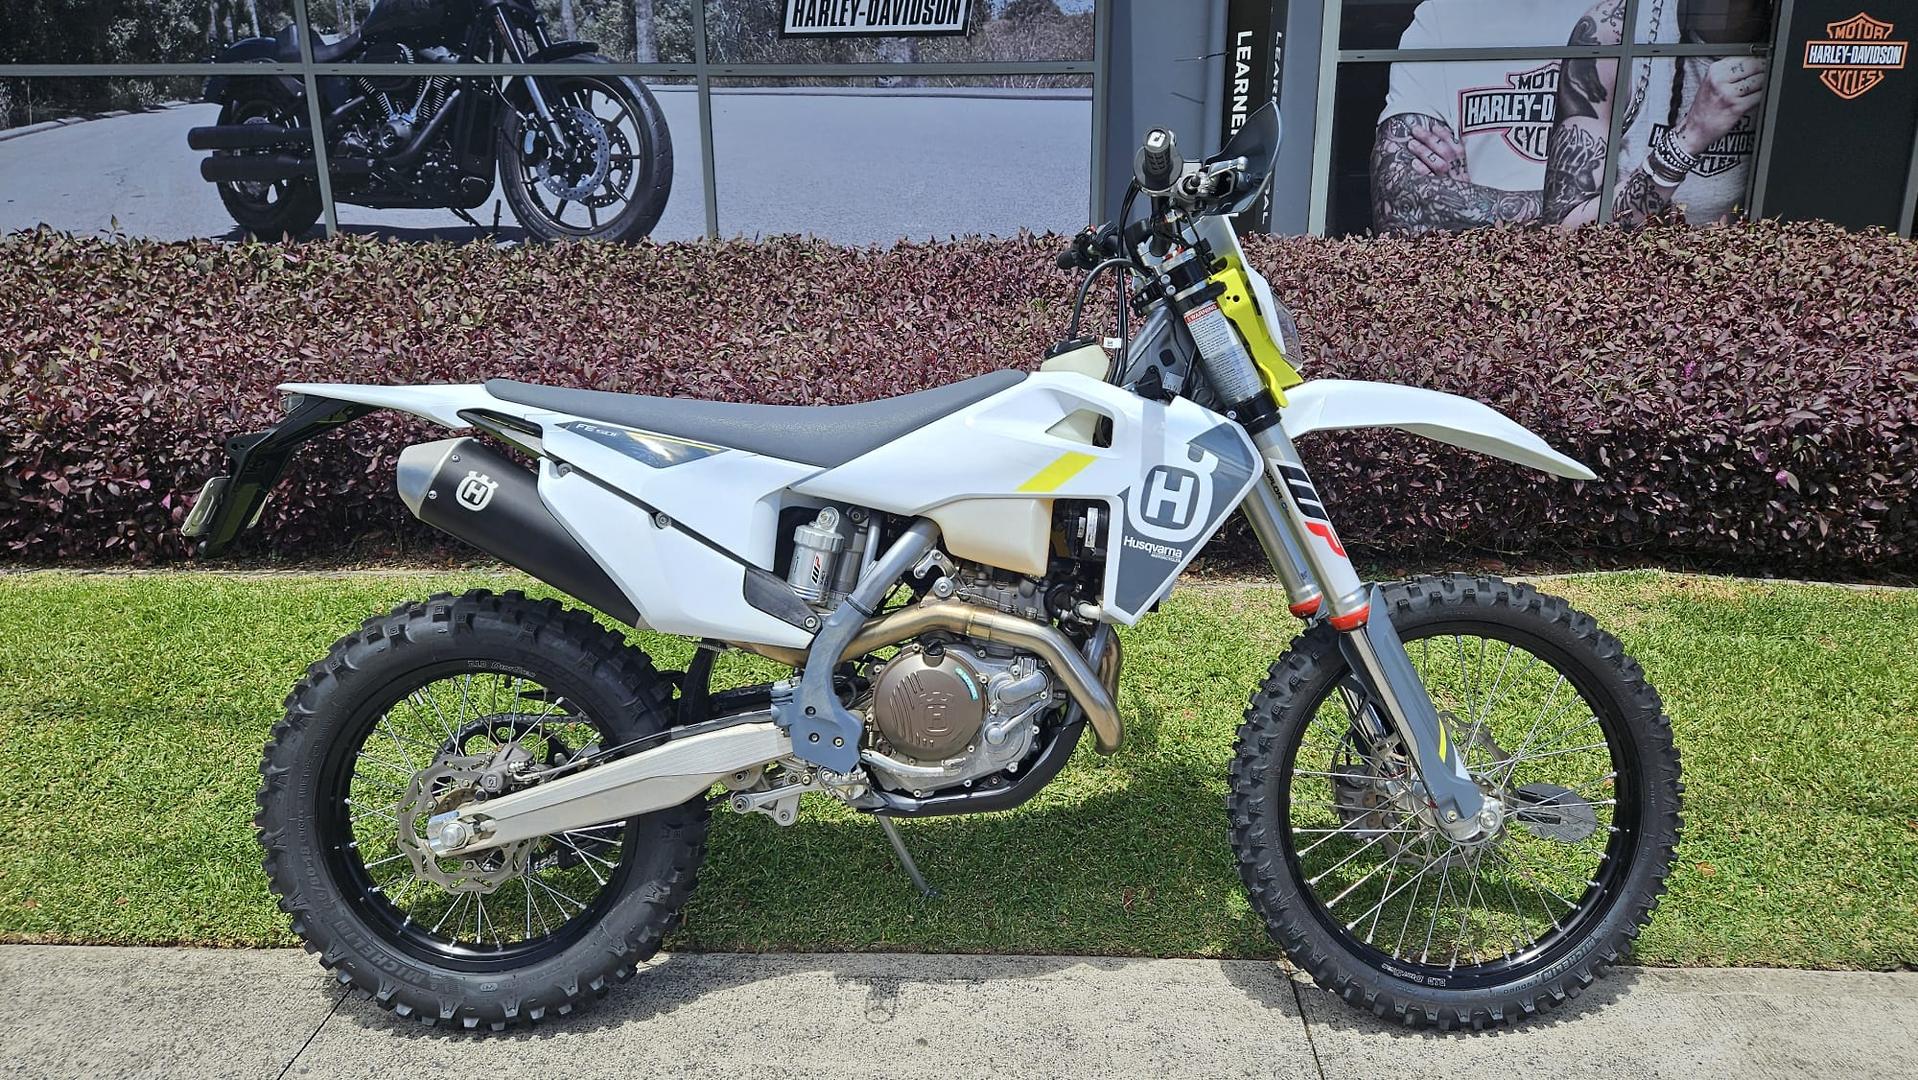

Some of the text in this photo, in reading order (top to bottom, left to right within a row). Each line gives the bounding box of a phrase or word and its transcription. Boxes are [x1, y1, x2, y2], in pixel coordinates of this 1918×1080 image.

[792, 0, 963, 27] HARLEY-DAVIDSON
[1835, 18, 1885, 39] MOTOR
[1808, 45, 1903, 64] HARLEY-DAVIDSON
[1828, 70, 1877, 94] CYCLES
[1466, 94, 1556, 124] HARLEY-D
[1123, 535, 1183, 558] Husqvarna
[1544, 937, 1599, 982] MICHELIN
